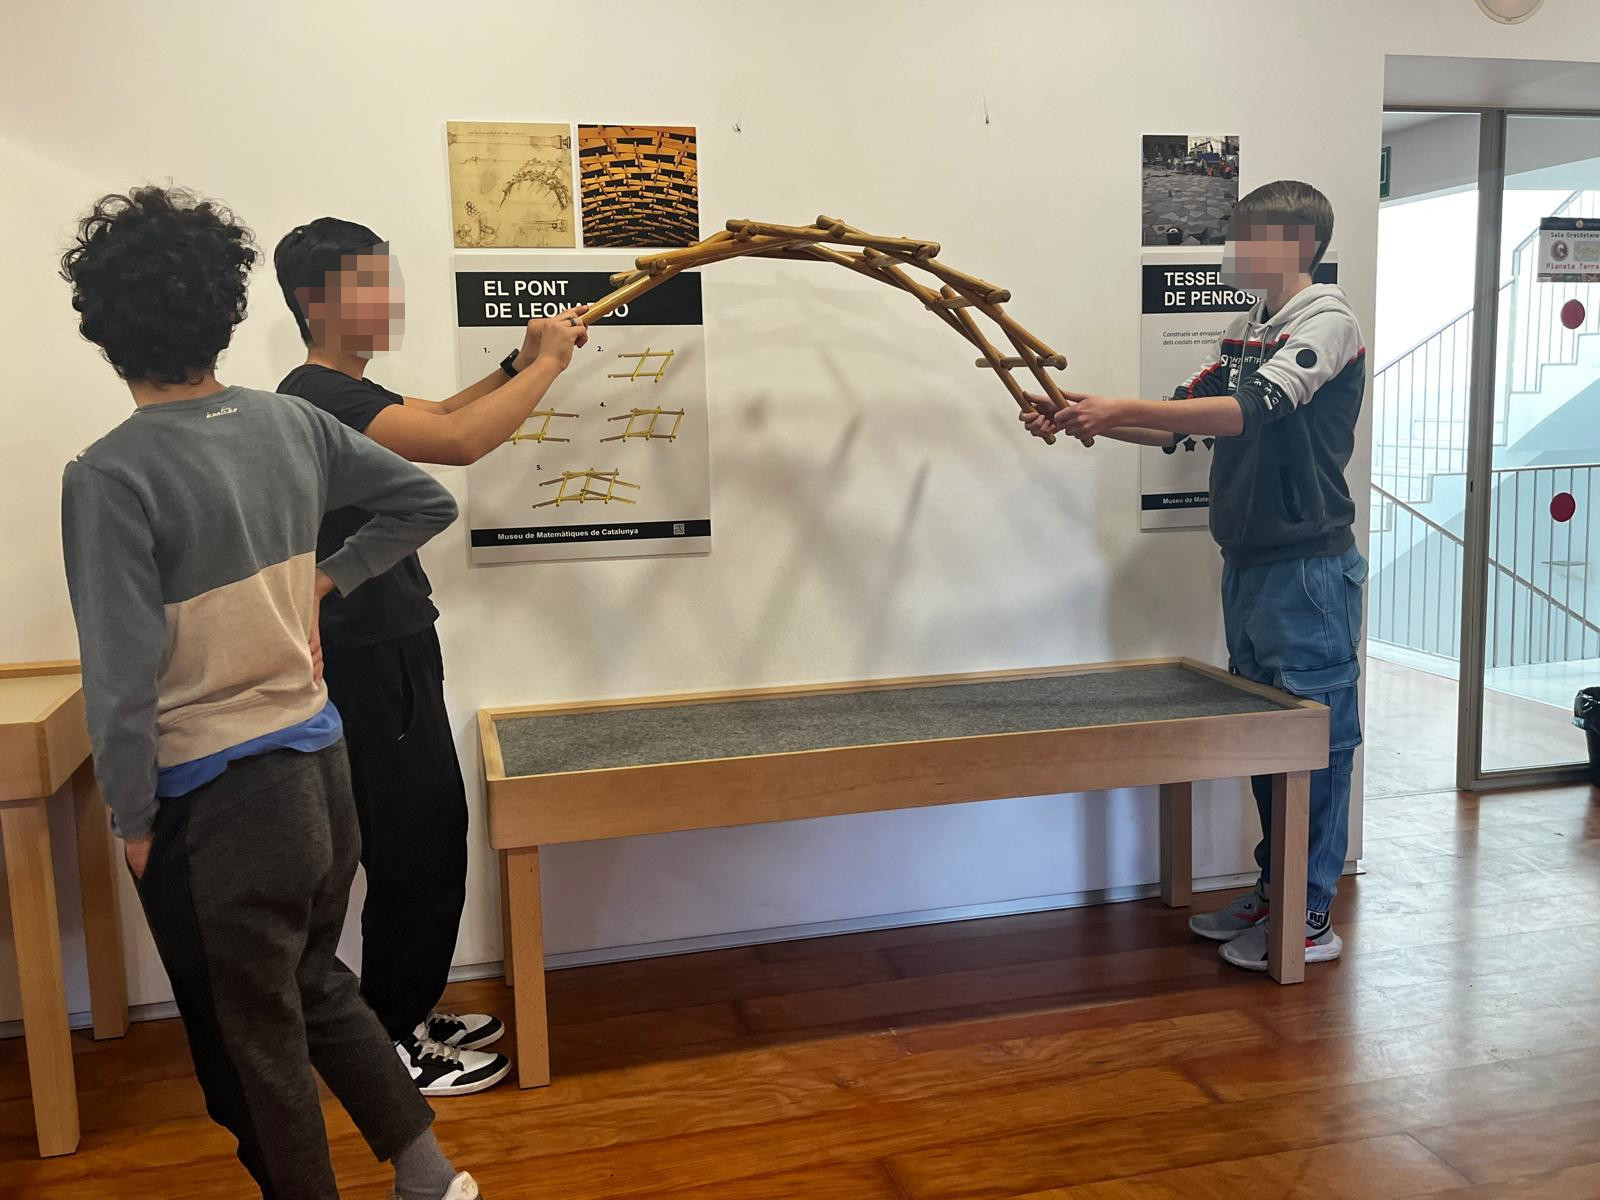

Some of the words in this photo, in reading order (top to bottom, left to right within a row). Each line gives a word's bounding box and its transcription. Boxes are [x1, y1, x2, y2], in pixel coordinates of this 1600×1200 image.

[484, 280, 509, 296] EL
[514, 280, 568, 296] PONT
[1164, 291, 1186, 306] DE
[485, 302, 512, 318] DE
[518, 302, 629, 318] LEONO
[536, 530, 589, 539] Matemàtiques
[601, 528, 639, 536] Catalunya
